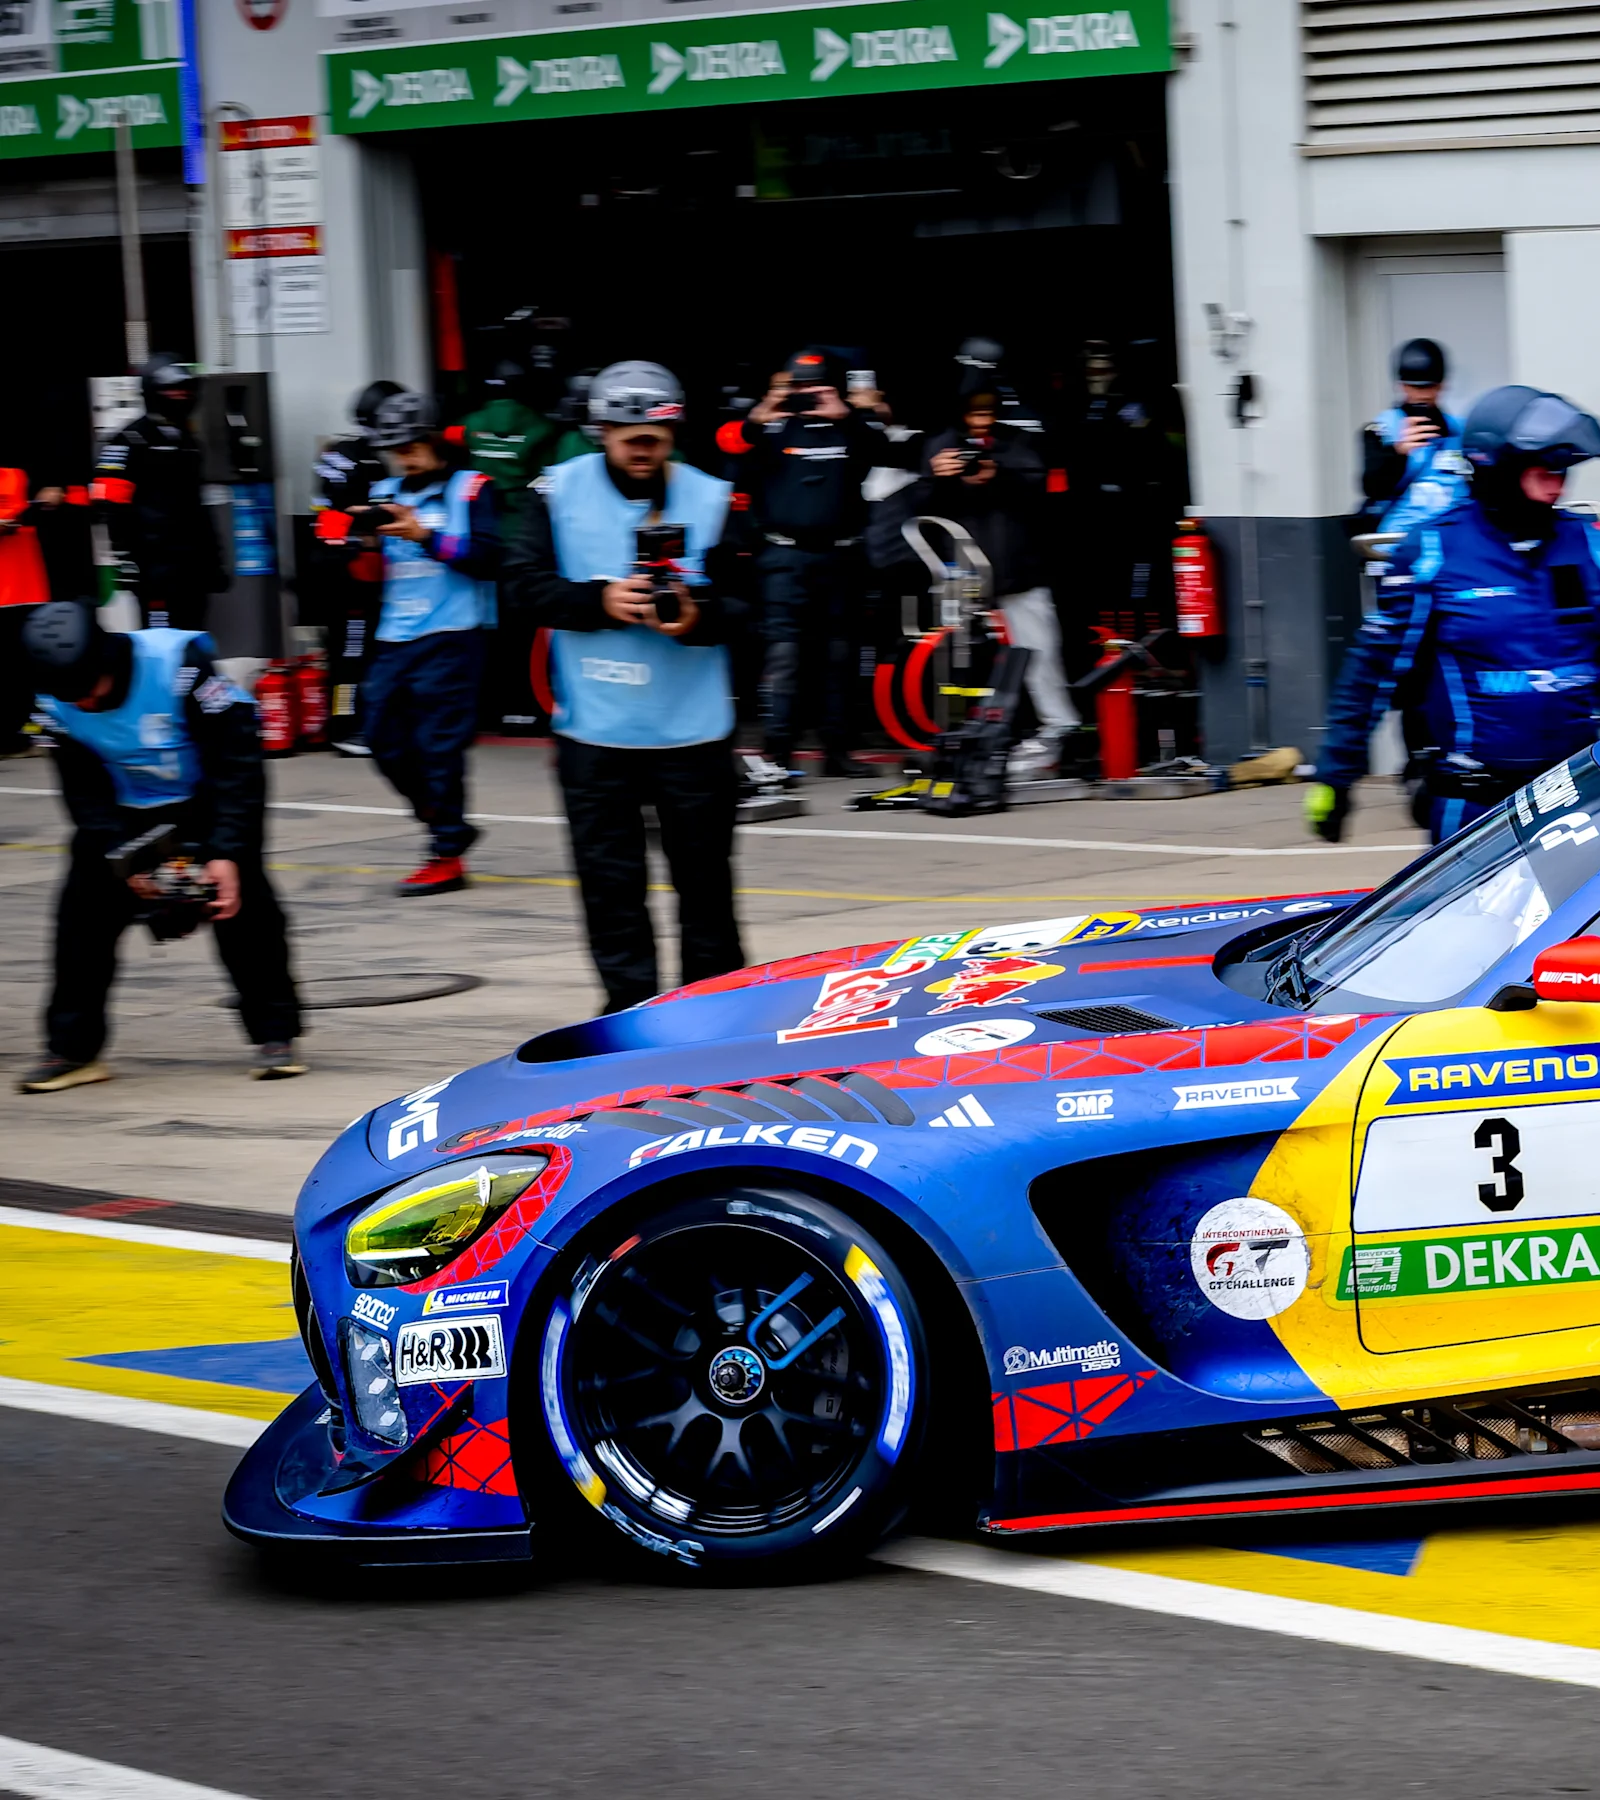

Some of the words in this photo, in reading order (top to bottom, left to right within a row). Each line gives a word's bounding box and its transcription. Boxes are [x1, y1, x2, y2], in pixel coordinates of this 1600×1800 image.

[851, 25, 958, 68] DEKRA
[1027, 10, 1140, 54] DEKRA
[529, 54, 626, 94] DEKRA
[686, 40, 786, 81] DEKRA
[1134, 906, 1274, 931] viaplay
[1057, 1094, 1113, 1116] OMP
[1186, 1084, 1287, 1103] RAVENOL
[388, 1073, 460, 1160] MG
[628, 1125, 879, 1169] FALKEN
[1473, 1117, 1525, 1213] 3
[1202, 1228, 1290, 1239] INTERCONTINENTAL
[1356, 1249, 1399, 1258] RAVENOL
[444, 1289, 501, 1301] MICHELIN
[1209, 1280, 1224, 1290] GT
[1226, 1277, 1296, 1290] CHALLENGE
[353, 1293, 399, 1326] sparco
[401, 1331, 447, 1373] H&R
[1029, 1339, 1120, 1367] Multimatic
[1081, 1357, 1121, 1373] DSSV
